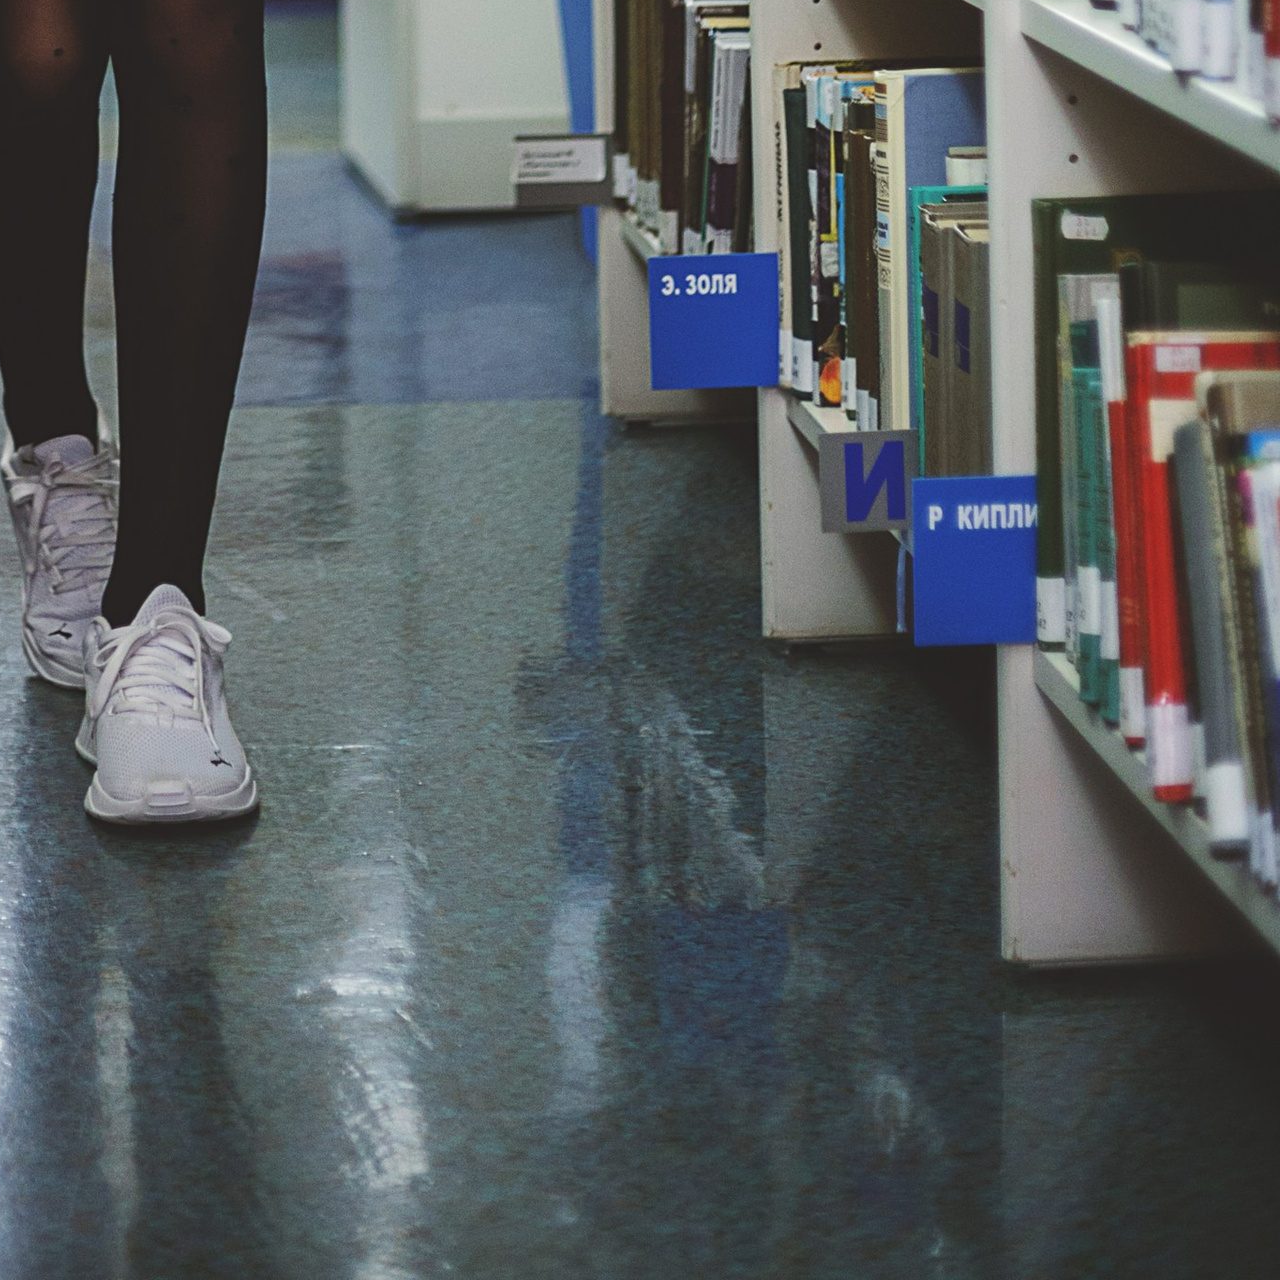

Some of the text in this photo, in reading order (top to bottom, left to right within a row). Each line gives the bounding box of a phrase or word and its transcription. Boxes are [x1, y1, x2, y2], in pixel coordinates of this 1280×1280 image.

[661, 274, 737, 296] Э. ЗОЛЯ
[844, 441, 907, 522] И
[958, 503, 1037, 530] КИПЛИ
